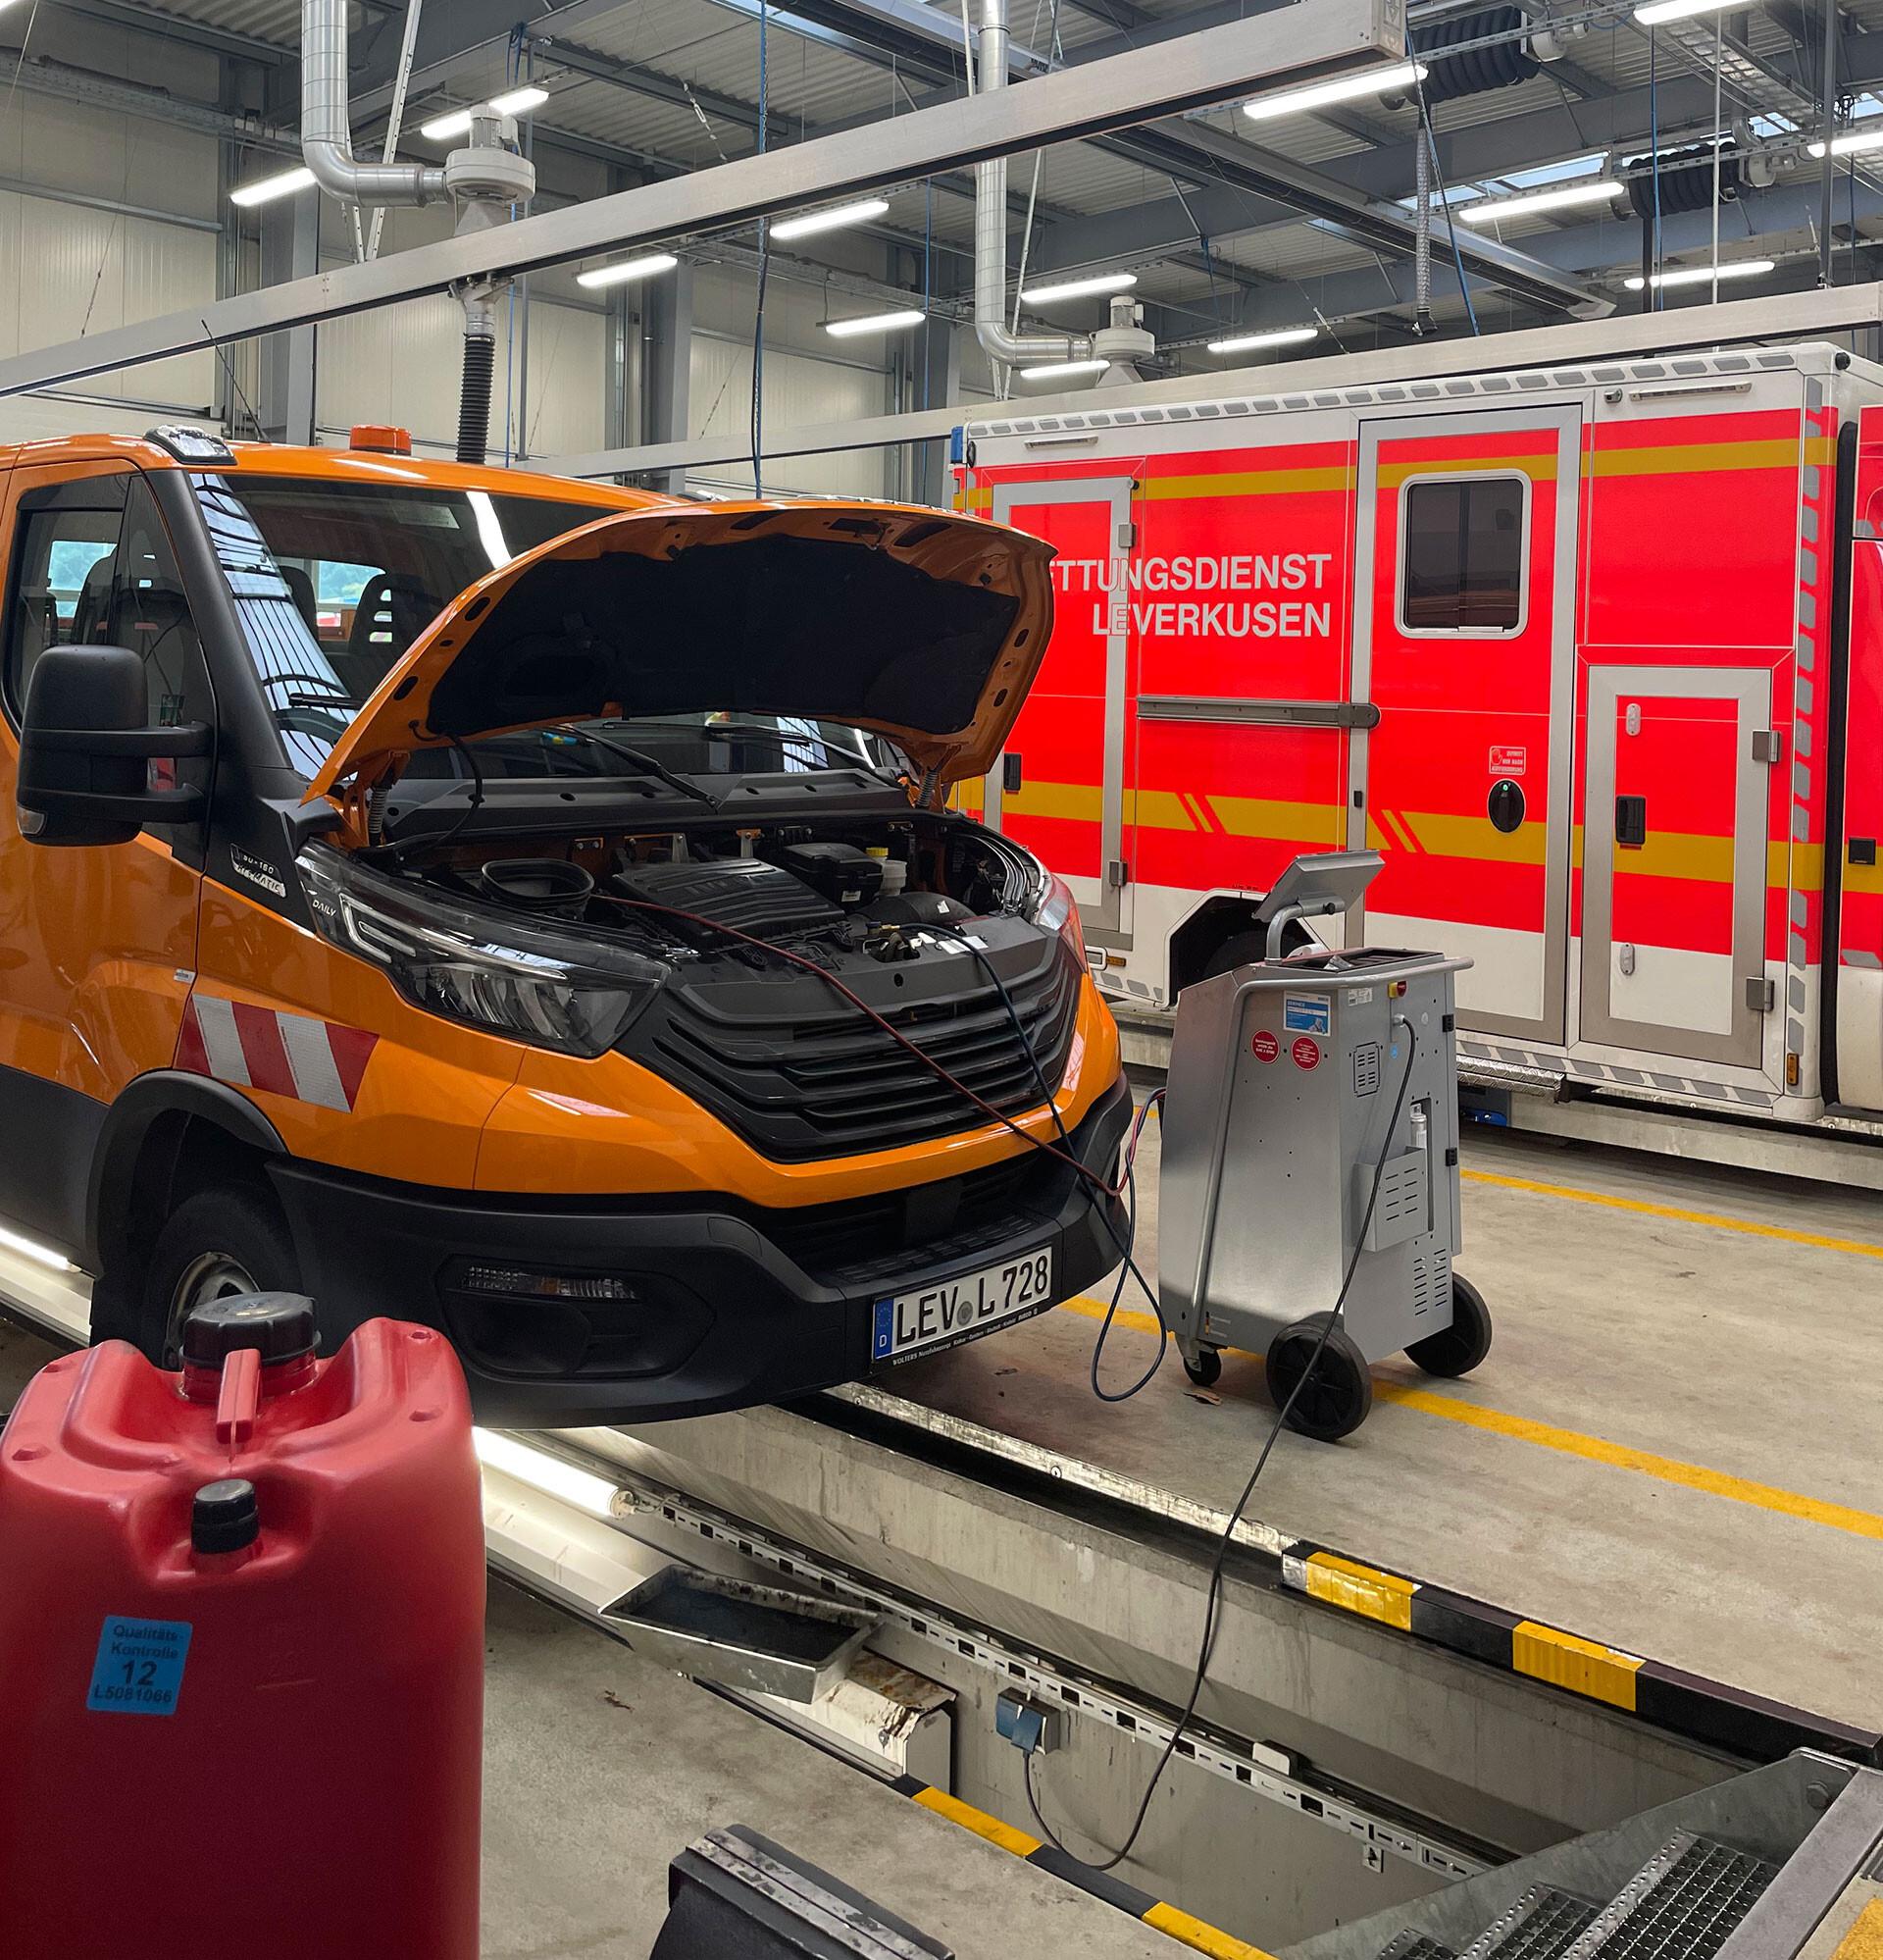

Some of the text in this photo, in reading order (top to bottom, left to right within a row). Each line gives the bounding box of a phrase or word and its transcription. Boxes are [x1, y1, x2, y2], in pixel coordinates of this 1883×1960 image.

[1049, 553, 1332, 592] TTUNGSDIENST
[1092, 602, 1331, 638] LEVERKUSEN
[312, 900, 336, 916] DAILY
[896, 1255, 1048, 1346] LEV L 728
[879, 1334, 888, 1348] D
[111, 1642, 178, 1659] Kontrolle
[123, 1660, 157, 1685] 12
[94, 1684, 172, 1703] L5081066
